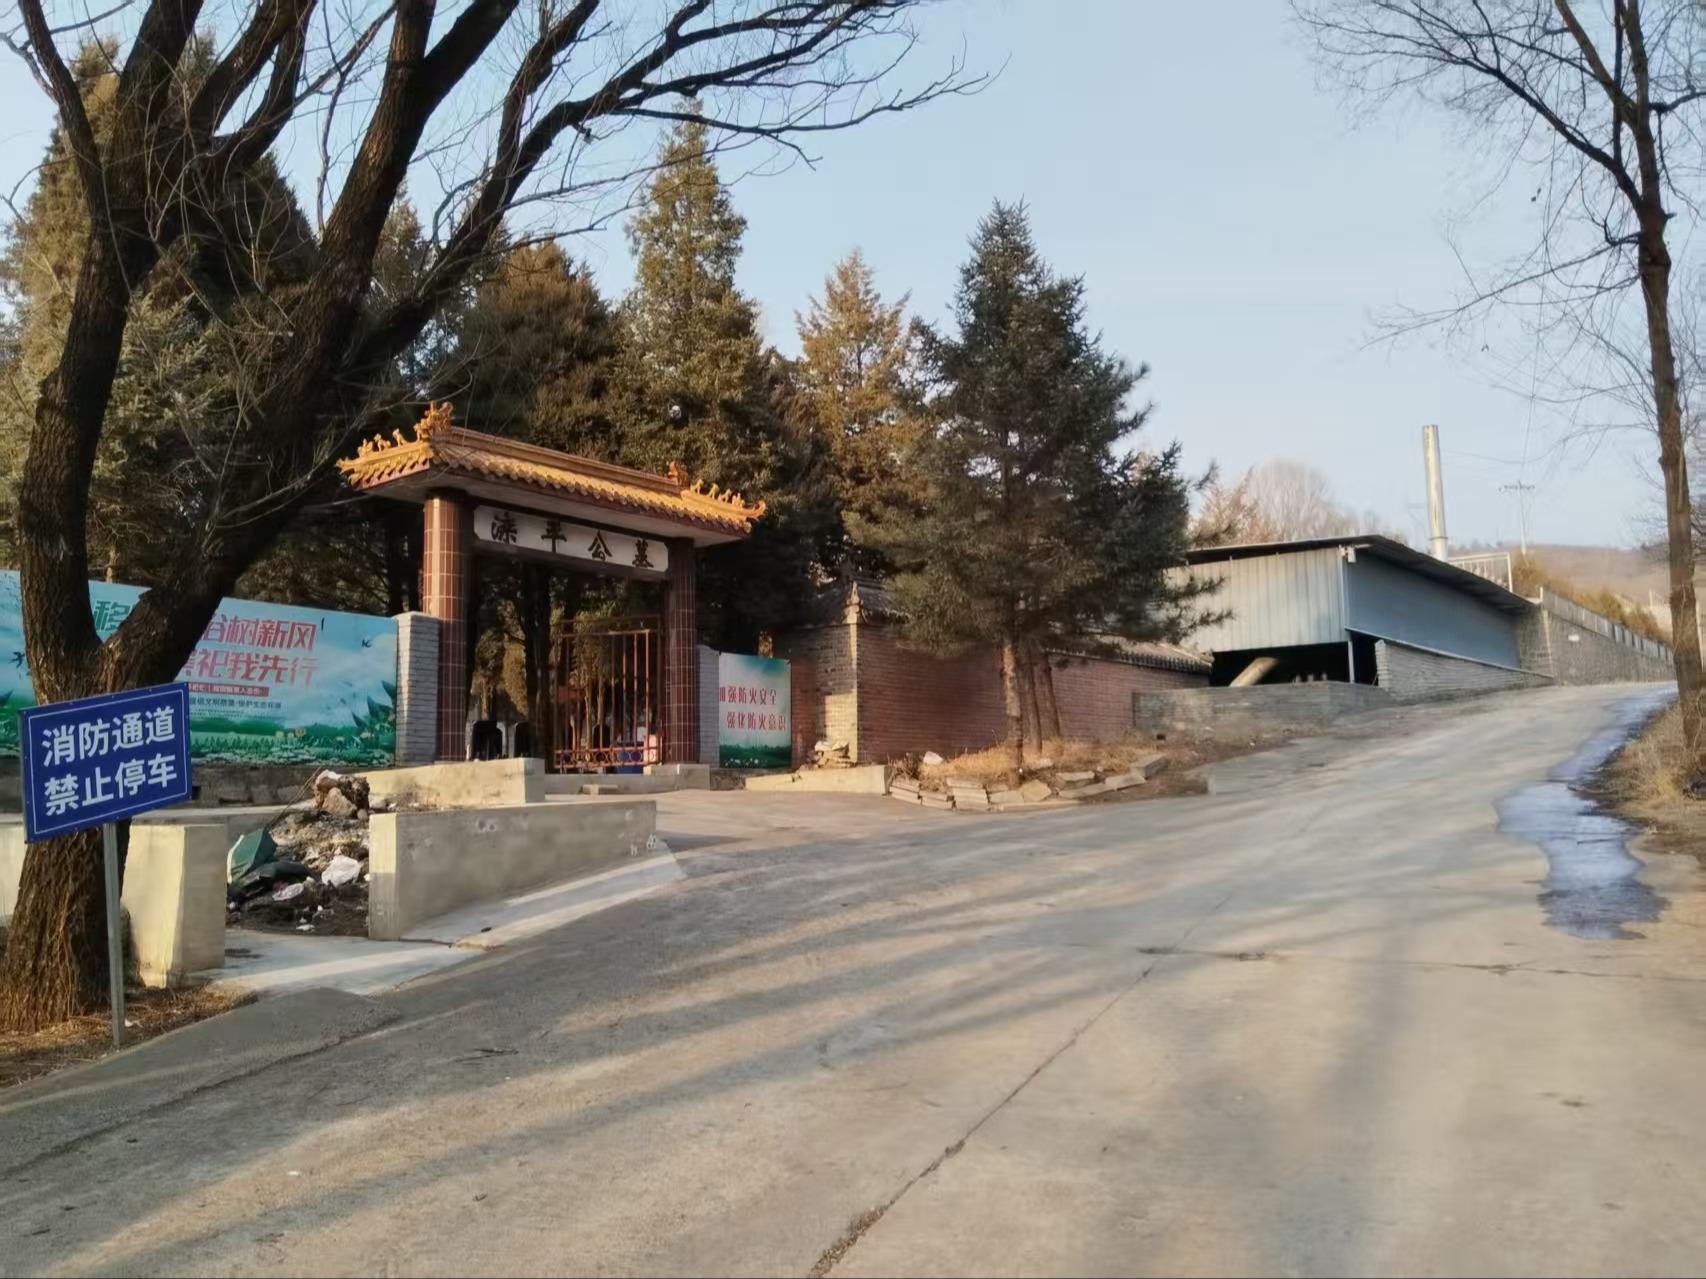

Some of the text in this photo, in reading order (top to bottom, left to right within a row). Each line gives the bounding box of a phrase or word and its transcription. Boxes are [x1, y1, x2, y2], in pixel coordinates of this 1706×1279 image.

[491, 511, 654, 568] 滦平公墓
[41, 705, 176, 768] 消防通道
[44, 753, 178, 816] 禁止停车
